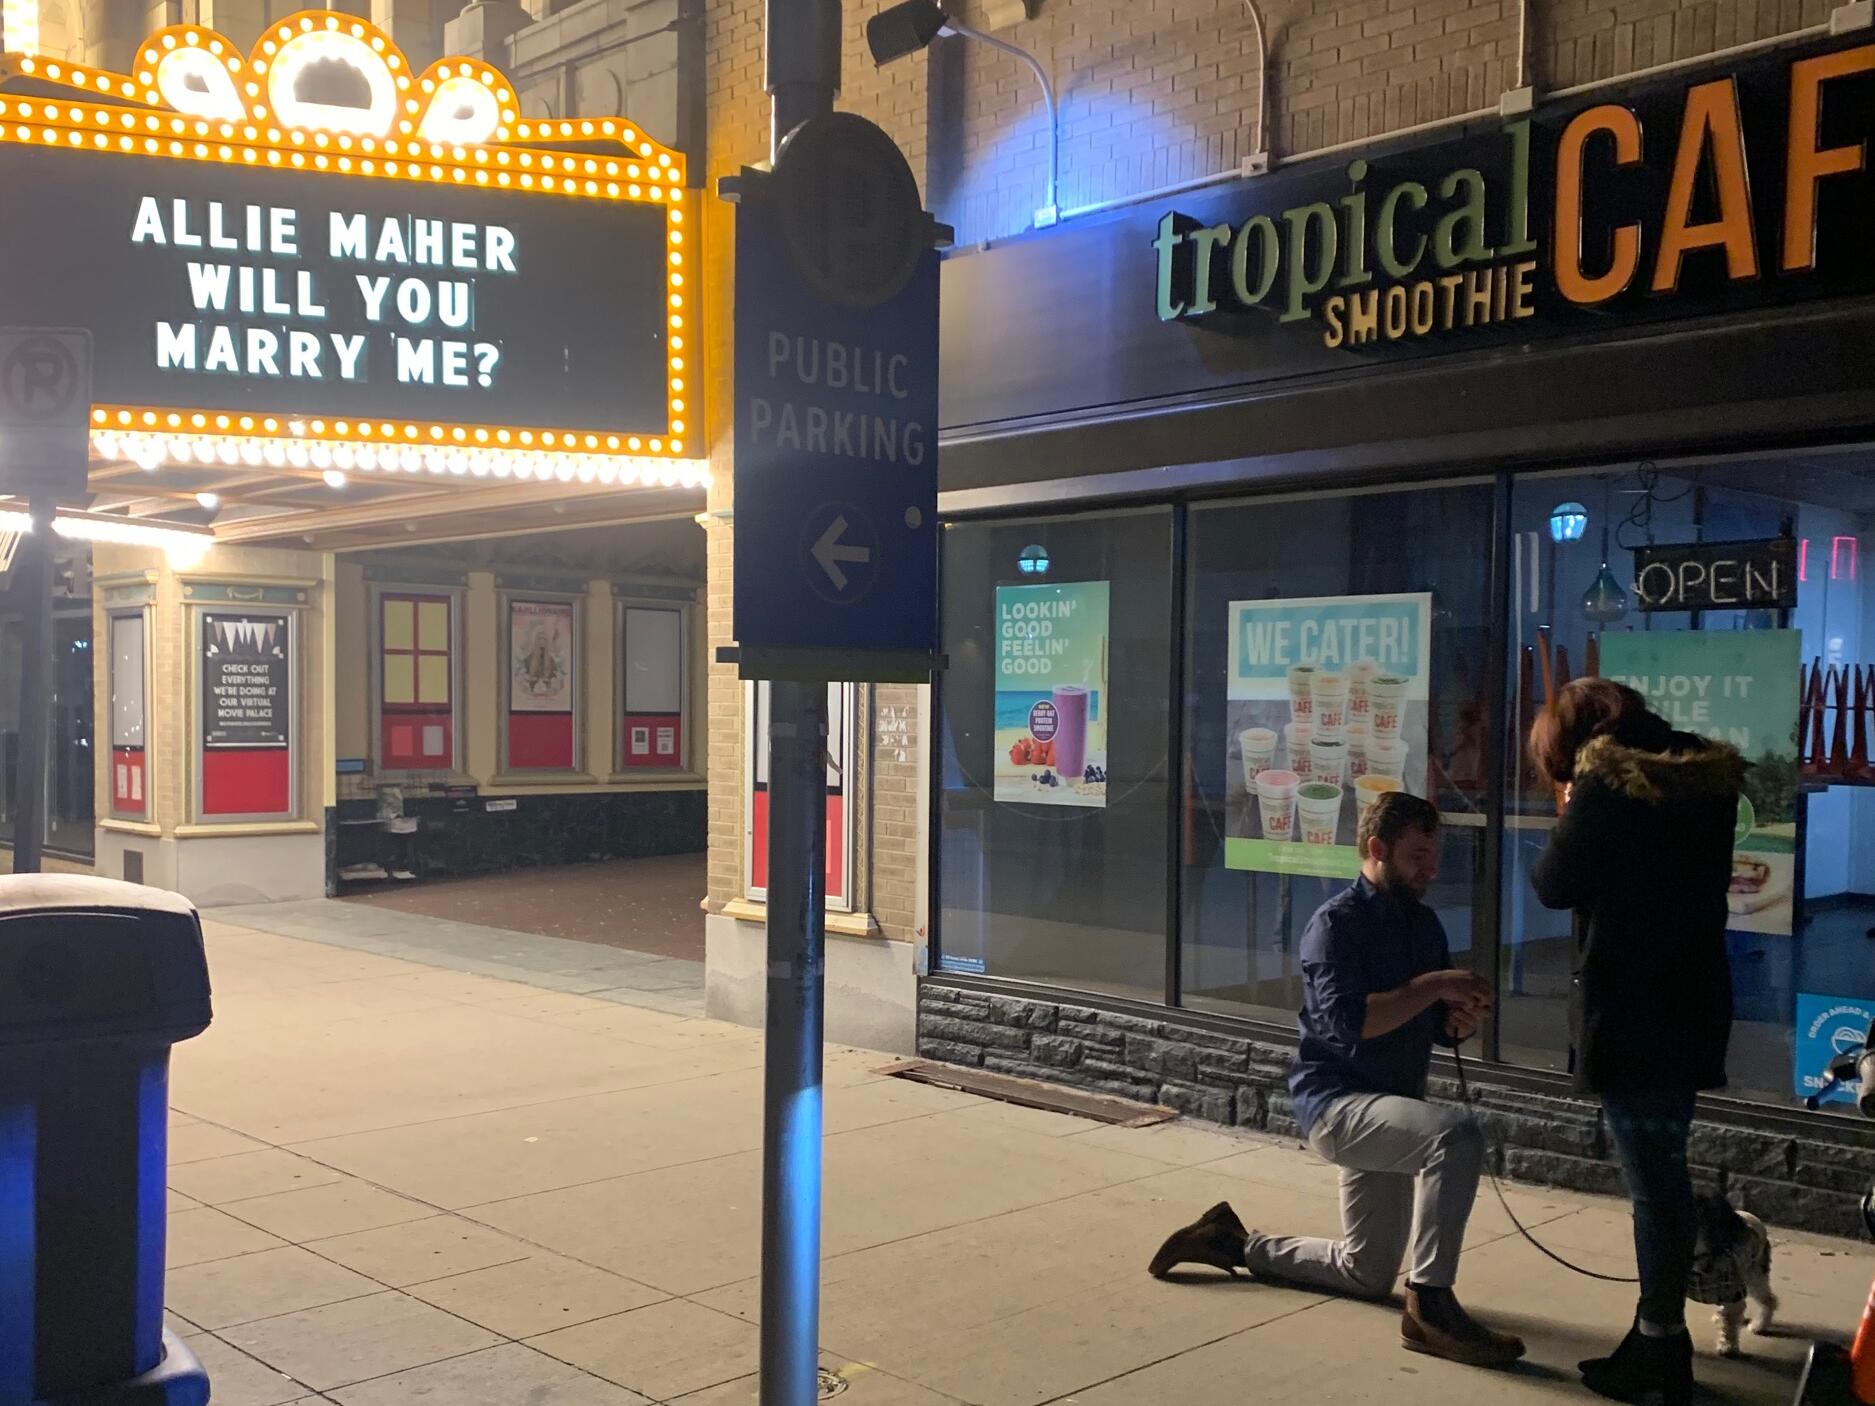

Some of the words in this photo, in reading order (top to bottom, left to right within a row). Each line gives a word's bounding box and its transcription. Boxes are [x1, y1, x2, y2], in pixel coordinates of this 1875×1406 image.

[131, 195, 298, 254] ALLIE
[329, 211, 517, 272] MAHER
[1151, 120, 1537, 324] tropical
[187, 261, 326, 317] WILL
[355, 274, 471, 328] YOU
[1323, 260, 1536, 349] SMOOTHIE
[156, 320, 367, 379] MARRY
[396, 336, 501, 389] ME?
[769, 330, 908, 399] PUBLIC
[750, 398, 924, 466] PARKING
[1639, 560, 1780, 604] OPEN
[1002, 600, 1077, 619] LOOKIN'
[1002, 620, 1053, 638] GOOD
[1245, 620, 1291, 665] WE
[1300, 616, 1410, 665] CATER!
[1001, 639, 1070, 656] FEELIN'
[221, 675, 270, 685] EVERYTHING
[222, 664, 249, 674] CHECK
[250, 665, 270, 674] OUT
[1001, 657, 1052, 674] GOOD
[213, 686, 238, 696] WE'RE
[239, 687, 266, 696] DOING
[267, 687, 277, 696] AT
[1723, 675, 1754, 699] IT
[218, 709, 244, 718] MOVIE
[245, 709, 273, 718] PALACE
[219, 698, 239, 706] OUR
[240, 698, 272, 707] VIRTUAL
[1807, 1012, 1831, 1039] ORDER
[1828, 1005, 1862, 1017] AHEAD
